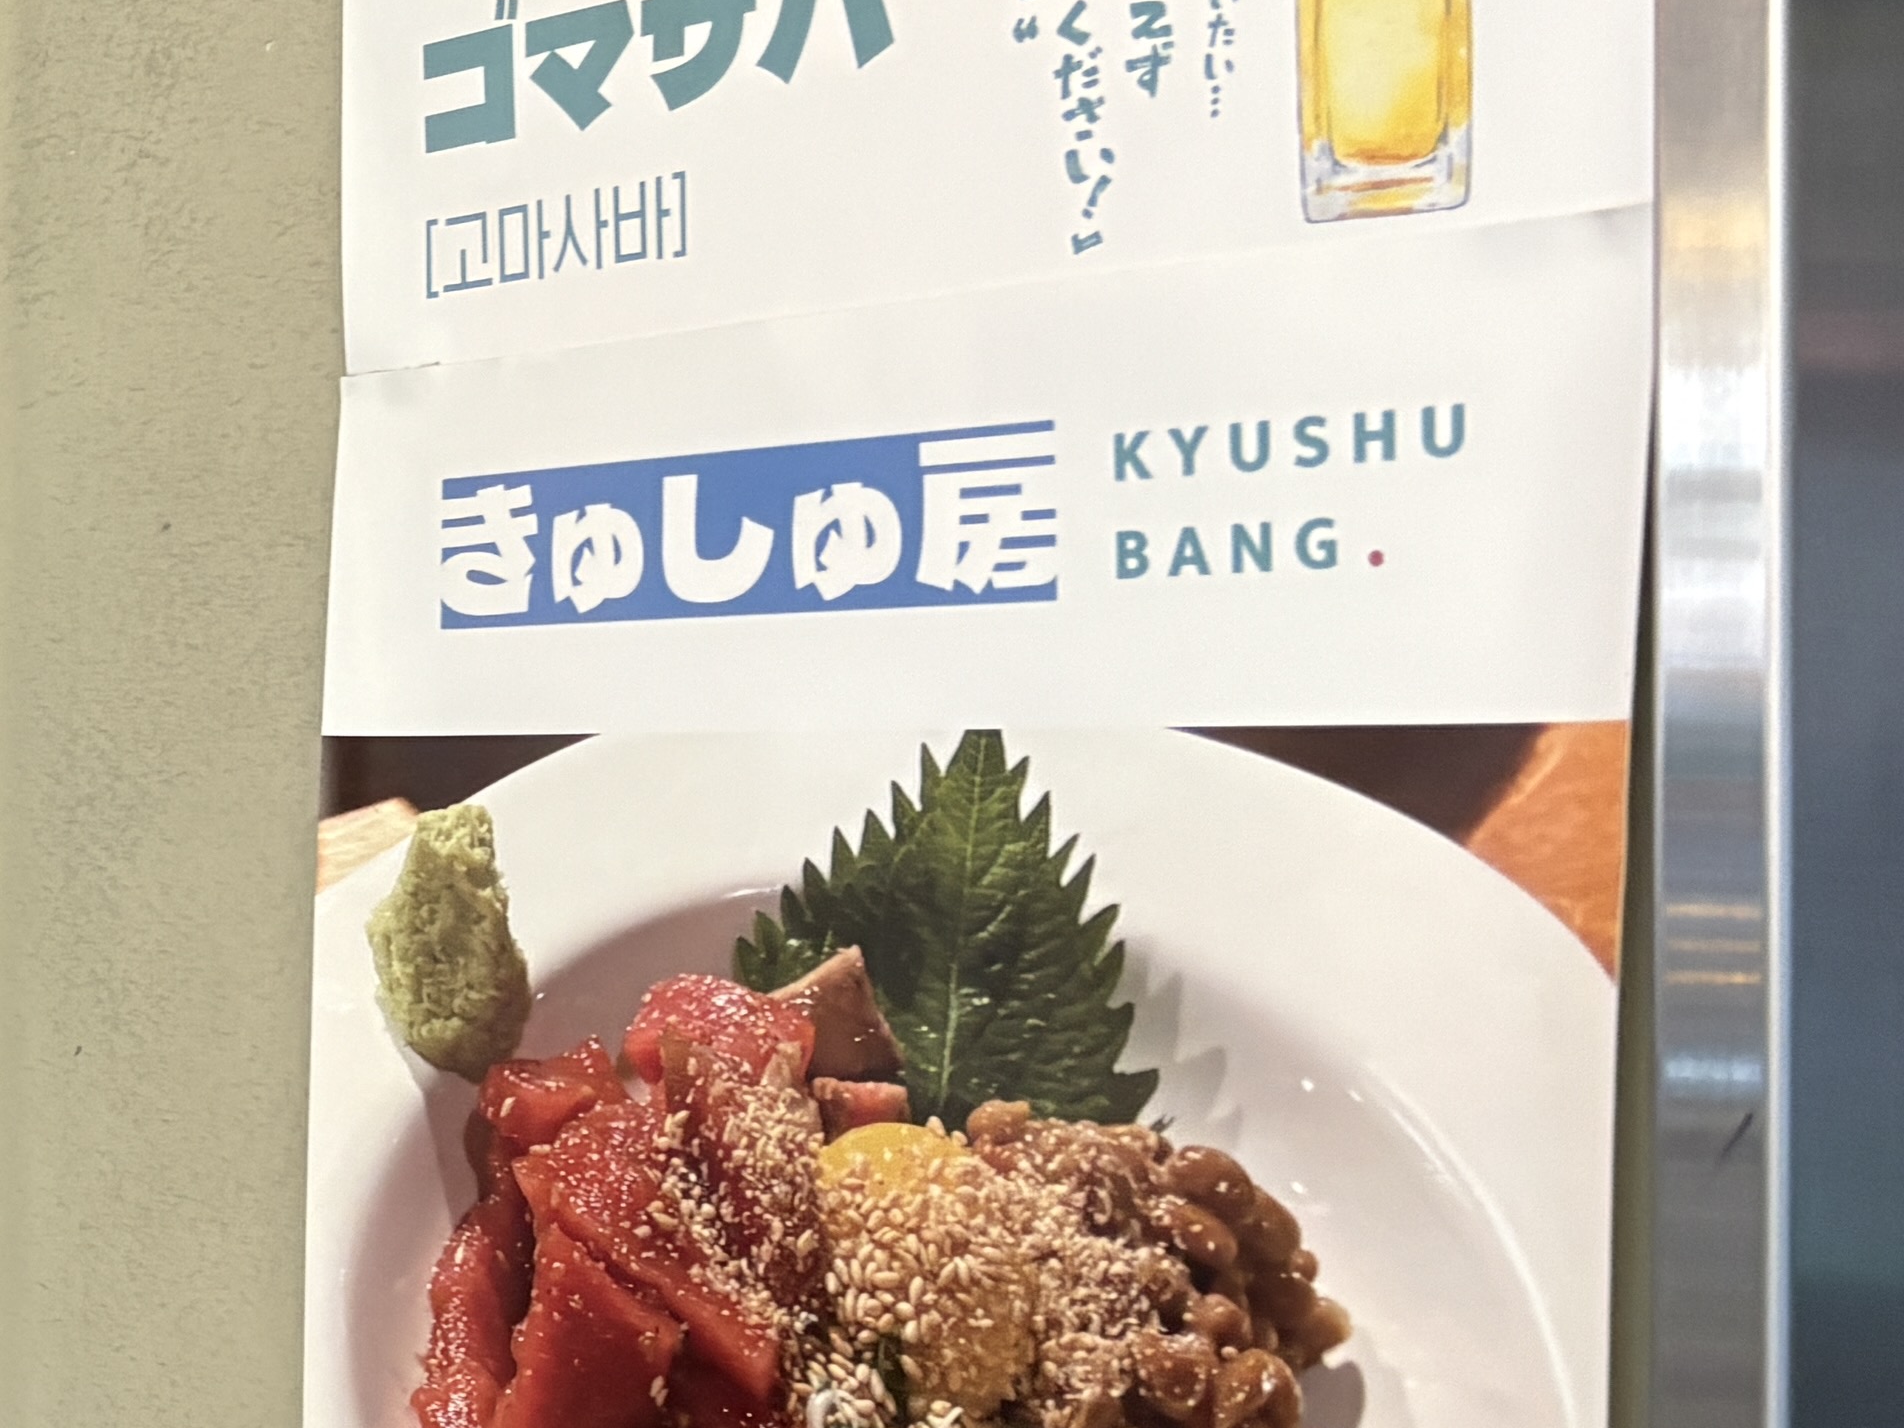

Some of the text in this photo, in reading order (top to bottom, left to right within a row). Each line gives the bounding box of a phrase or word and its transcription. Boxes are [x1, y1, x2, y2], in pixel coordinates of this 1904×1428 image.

[425, 170, 688, 300] [고마사바]
[1112, 402, 1469, 482] KYUSHU
[440, 428, 1057, 622] きゅしゅ房
[1112, 514, 1385, 582] BANG.
